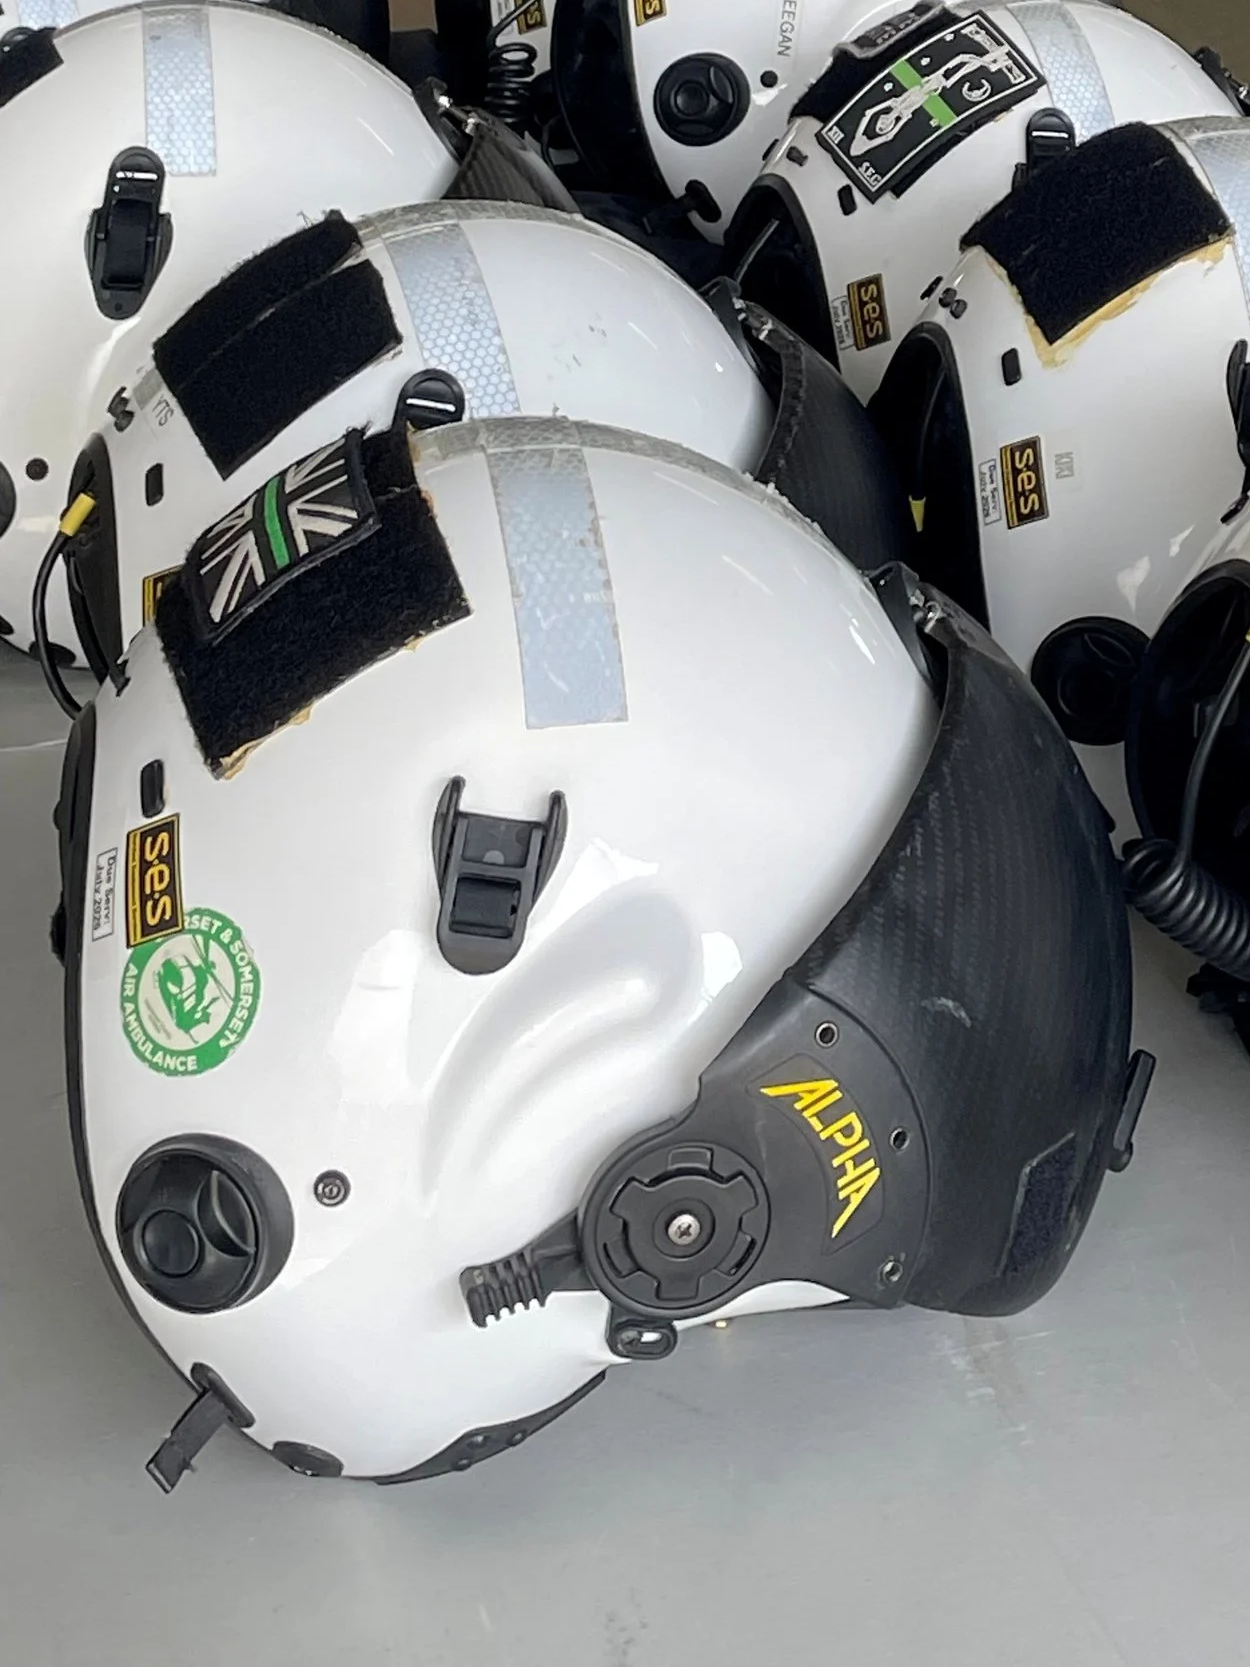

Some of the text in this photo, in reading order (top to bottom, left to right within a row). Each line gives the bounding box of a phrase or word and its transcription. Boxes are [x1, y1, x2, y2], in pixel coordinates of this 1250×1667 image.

[122, 962, 139, 998] AIR
[218, 939, 255, 1048] SOMERSET
[122, 1003, 198, 1072] AMBULANCE
[759, 1078, 881, 1239] ALPHA
